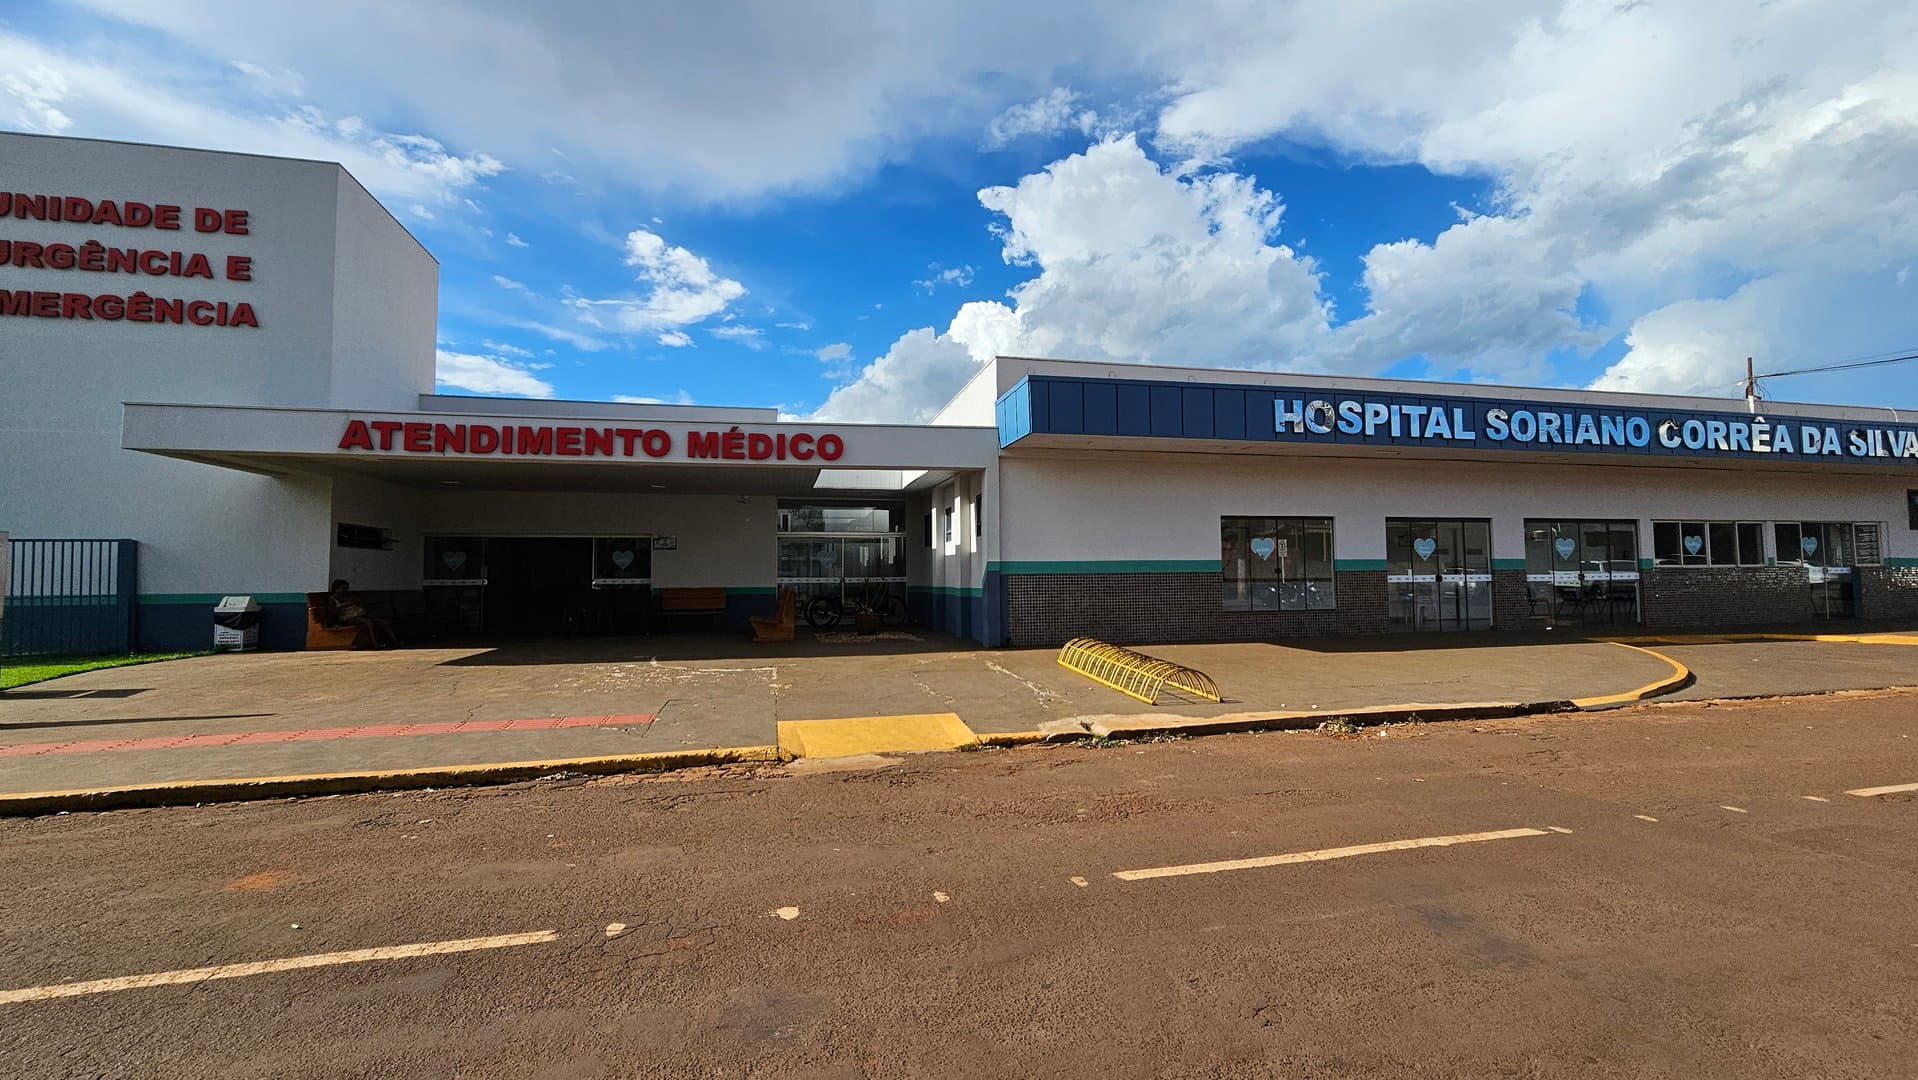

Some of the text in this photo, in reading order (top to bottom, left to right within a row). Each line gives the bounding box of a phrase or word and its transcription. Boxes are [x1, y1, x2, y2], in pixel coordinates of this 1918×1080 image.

[195, 207, 249, 234] DE
[227, 255, 252, 281] E
[339, 419, 845, 461] ATENDIMENTO MÉDICO
[1274, 399, 1918, 458] HOSPITAL SORIANO CORRÊA DA SILVA
